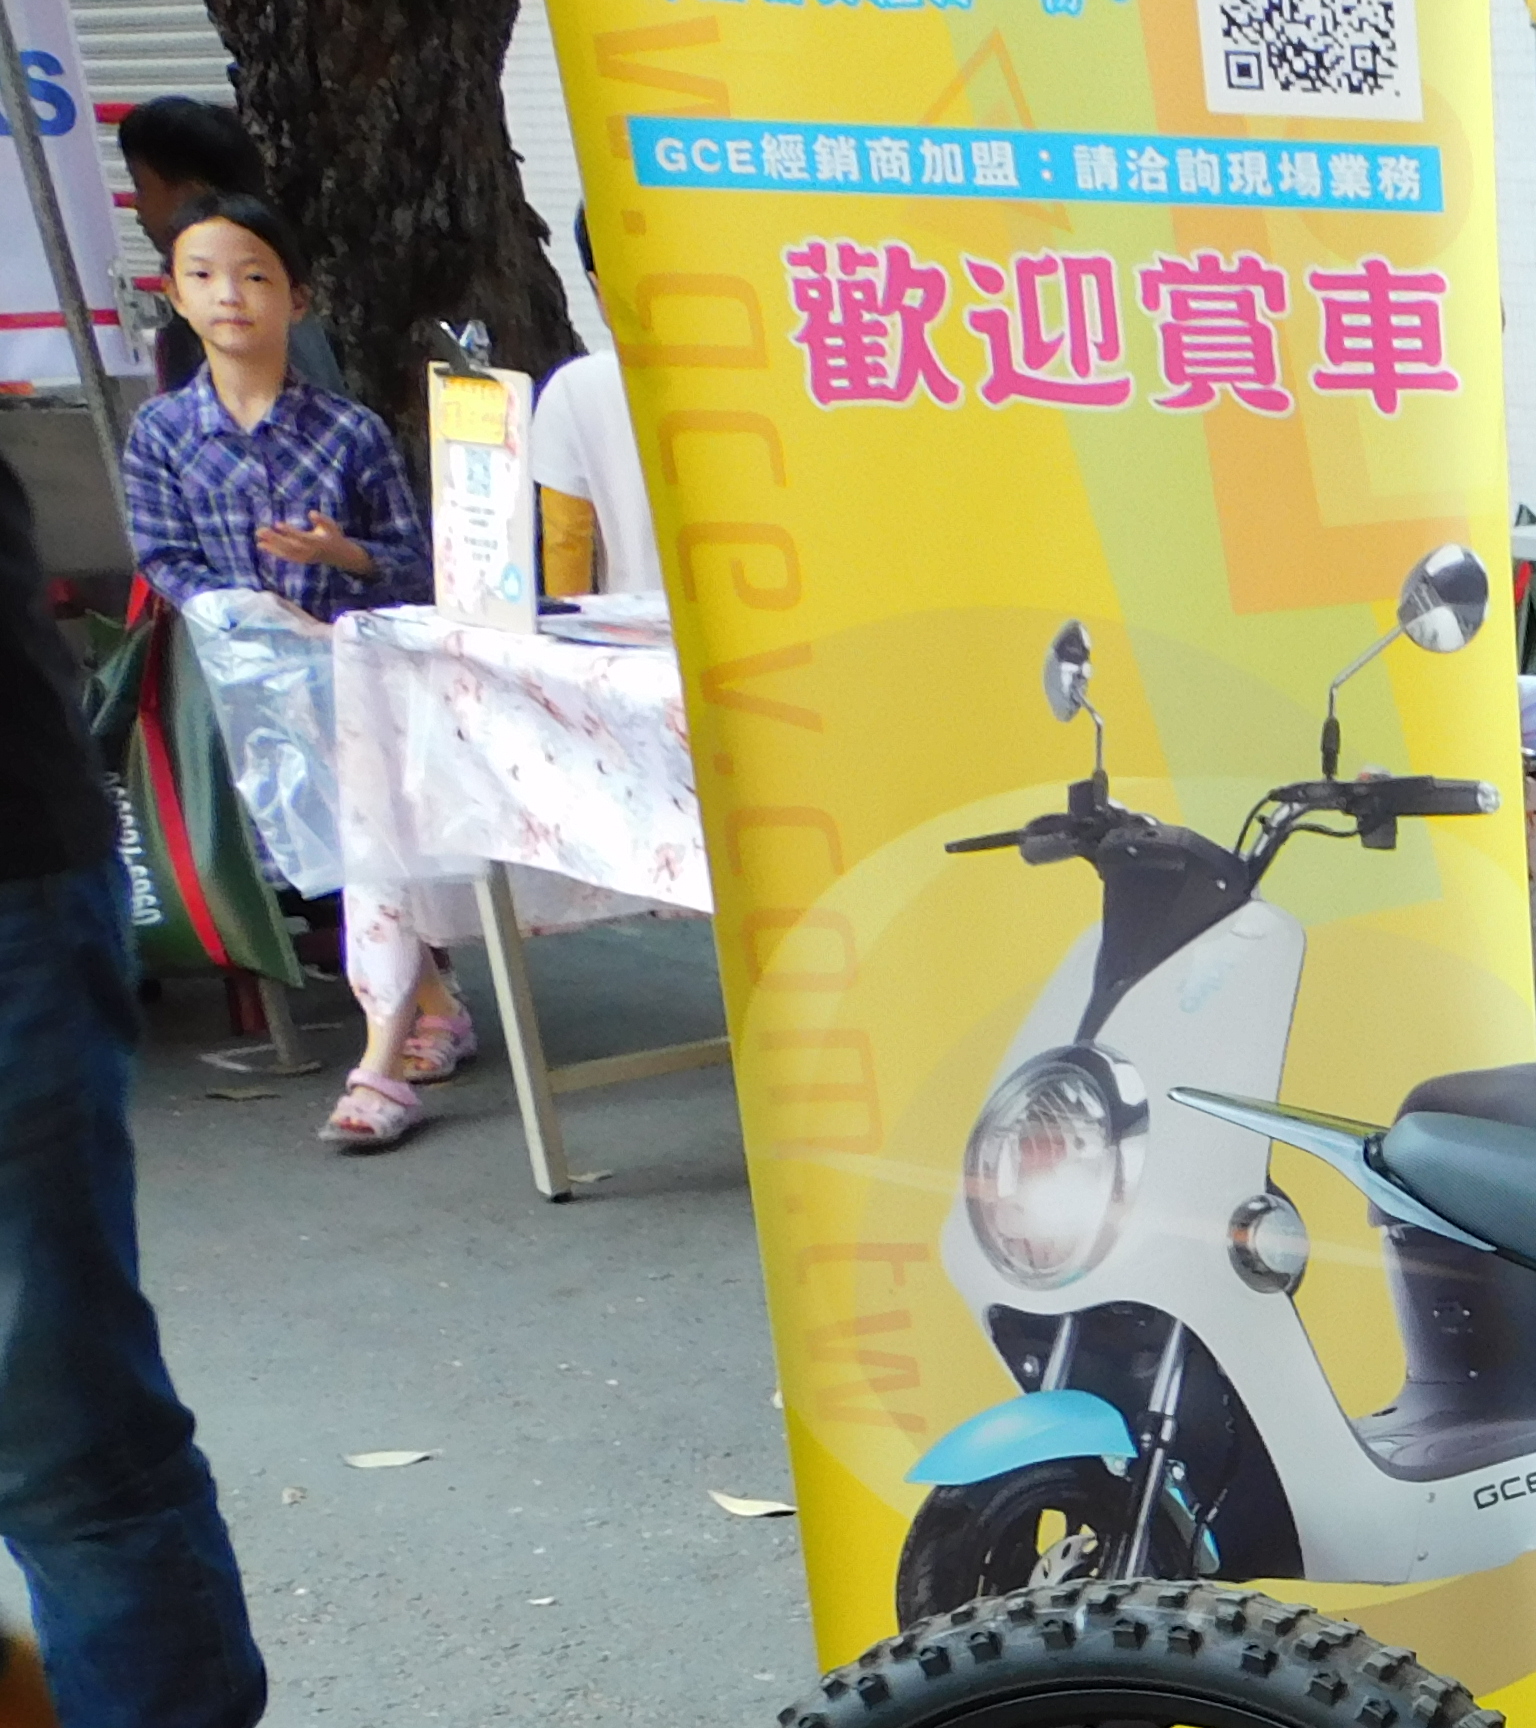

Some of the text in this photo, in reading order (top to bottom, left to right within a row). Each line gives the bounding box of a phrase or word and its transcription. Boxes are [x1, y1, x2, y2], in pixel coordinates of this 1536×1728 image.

[0, 49, 77, 136] S
[785, 241, 1460, 416] 歡迎賞車
